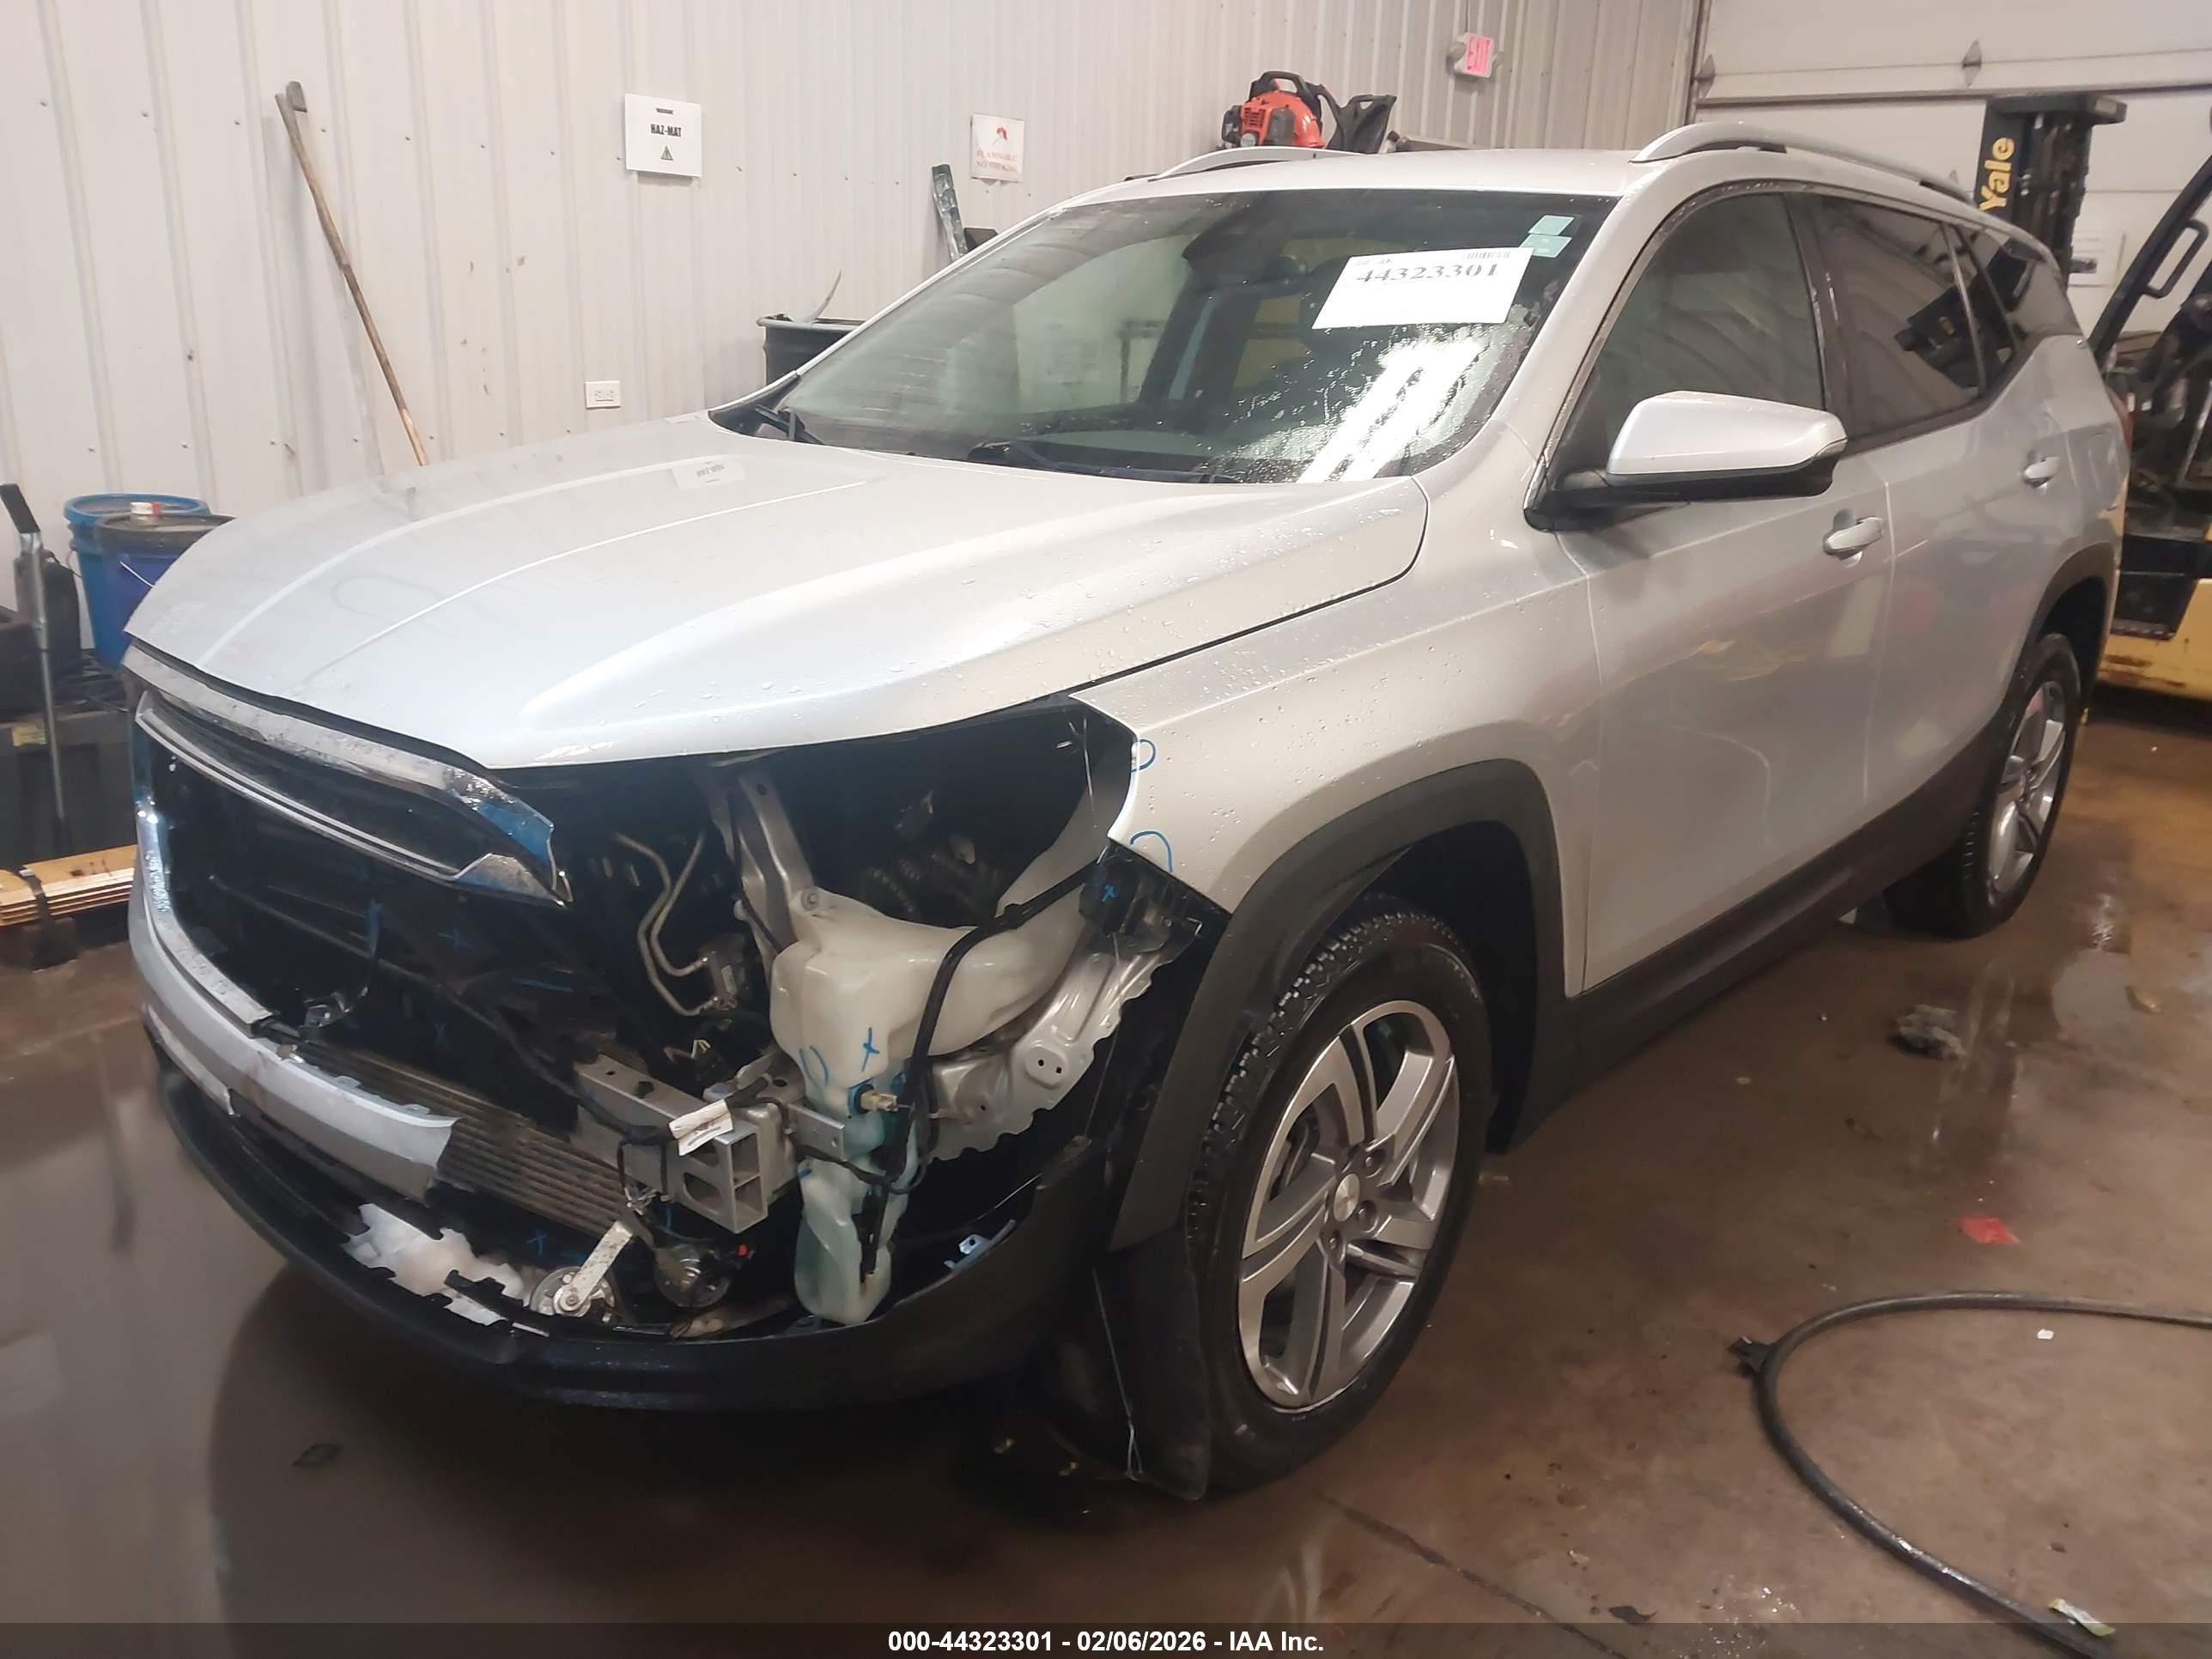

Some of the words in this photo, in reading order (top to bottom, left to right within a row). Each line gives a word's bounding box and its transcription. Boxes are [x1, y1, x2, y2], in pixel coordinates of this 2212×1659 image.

[650, 124, 682, 137] HAZ-MAT
[1979, 137, 2015, 211] Yale
[1356, 263, 1498, 283] 44323301
